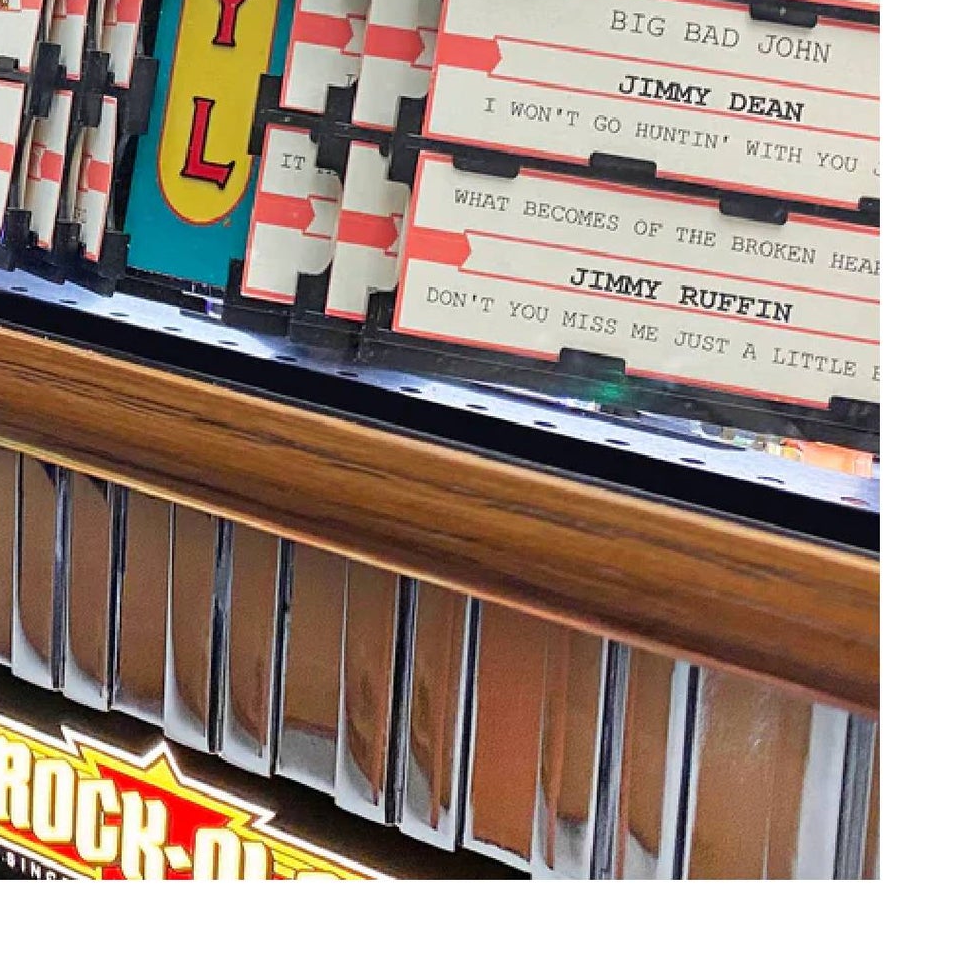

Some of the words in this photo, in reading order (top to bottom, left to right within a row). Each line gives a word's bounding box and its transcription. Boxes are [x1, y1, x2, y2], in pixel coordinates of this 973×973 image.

[610, 9, 666, 37] BIG
[684, 20, 741, 49] BAD
[757, 34, 832, 65] JOHN
[618, 74, 713, 108] JIMMY
[727, 92, 806, 123] DEAN
[280, 153, 306, 171] IT
[483, 97, 496, 114] I
[511, 100, 579, 128] WON'T
[593, 115, 622, 135] GO
[635, 121, 729, 151] HUNTIN'
[745, 139, 803, 164] WITH
[816, 152, 858, 174] YOU
[454, 188, 511, 213] WHAT
[522, 200, 620, 234] BECOMES
[633, 220, 664, 239] OF
[675, 227, 718, 248] THE
[730, 235, 817, 266] BROKEN
[569, 266, 663, 301] JIMMY
[678, 284, 794, 325] RUFFIN
[426, 285, 495, 314] DON'T
[509, 300, 549, 324] YOU
[561, 310, 618, 336] MISS
[630, 323, 659, 343] ME
[674, 331, 731, 355] JUST
[741, 343, 758, 361] A
[772, 347, 857, 379] LITTLE
